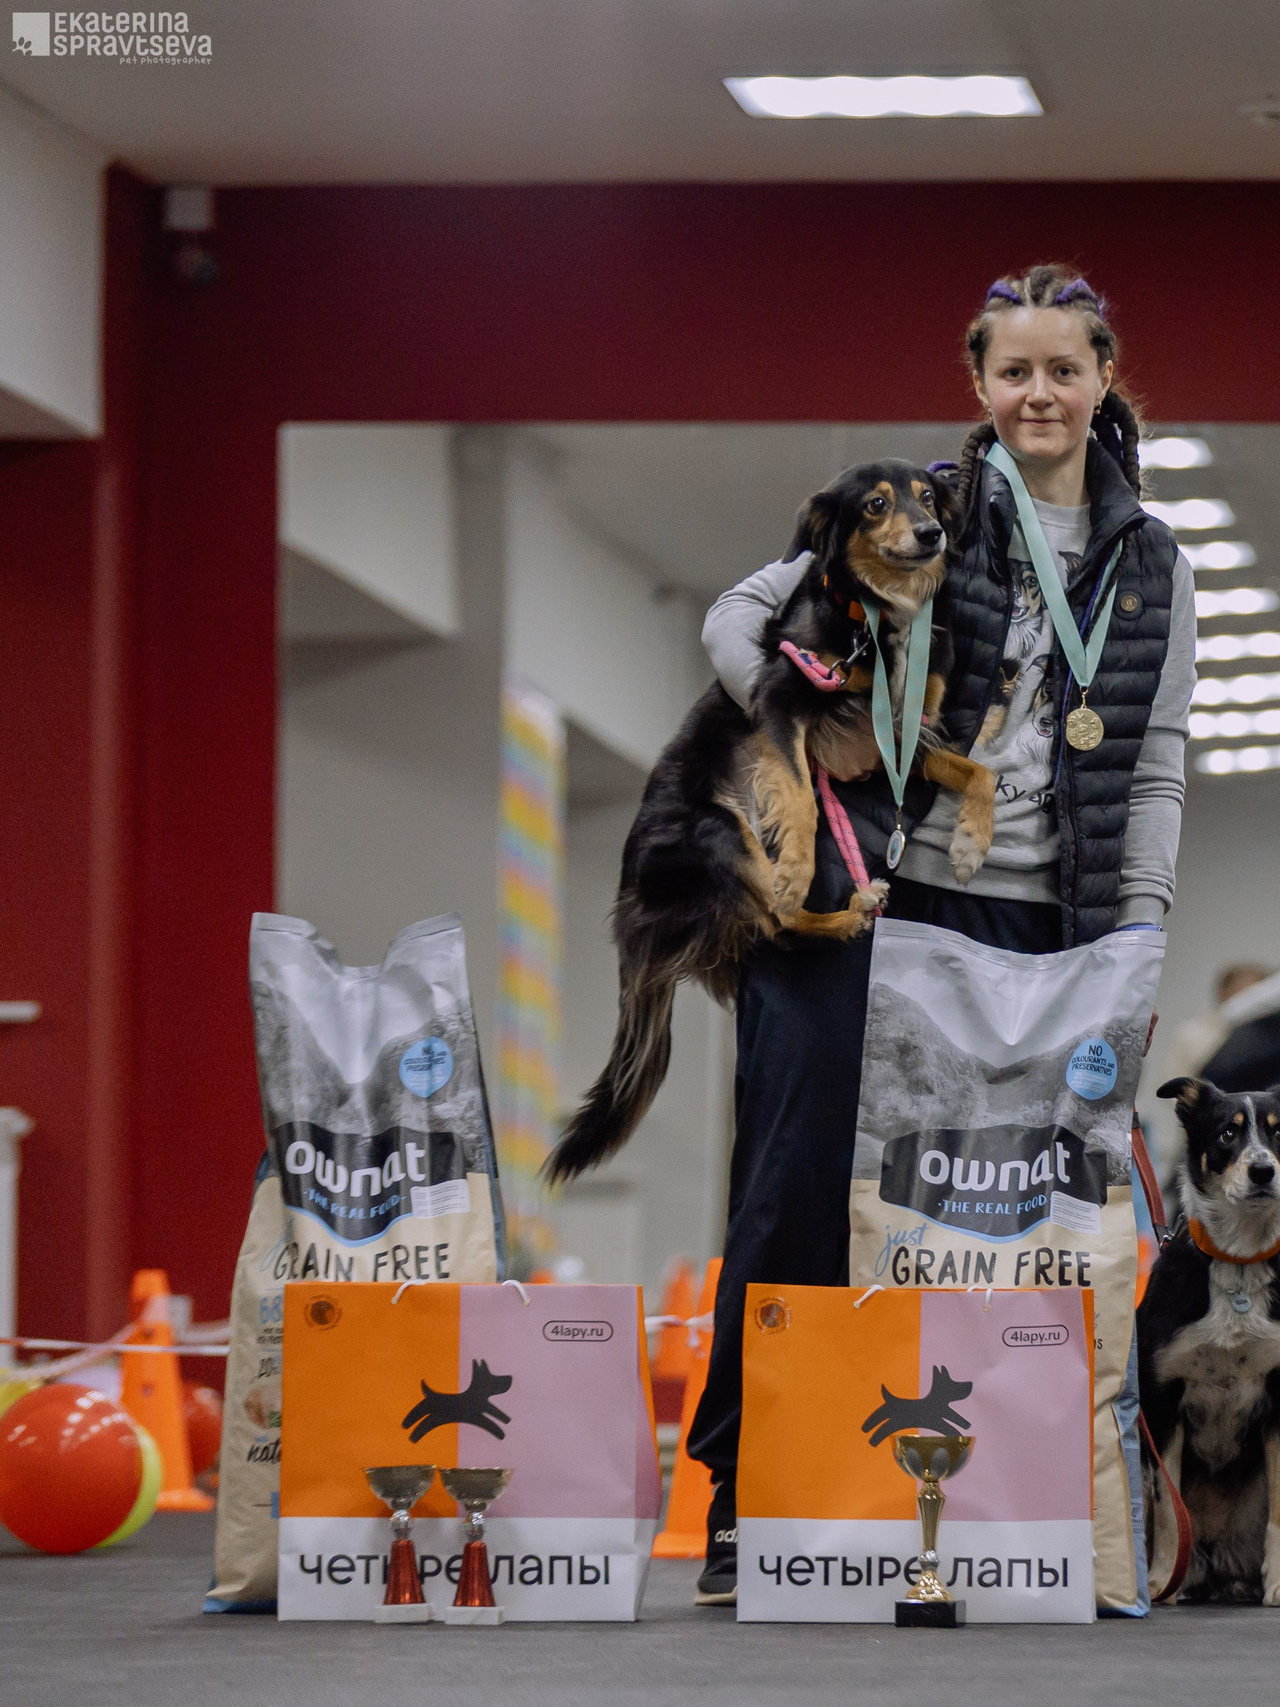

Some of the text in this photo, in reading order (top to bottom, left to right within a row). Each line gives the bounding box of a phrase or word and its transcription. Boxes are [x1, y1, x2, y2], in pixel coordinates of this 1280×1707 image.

[1088, 1044, 1103, 1056] NO
[285, 1140, 426, 1197] ownat
[919, 1141, 1071, 1192] ownat
[942, 1194, 1047, 1215] THE REAL FOOD
[373, 1243, 450, 1282] FREE
[874, 1222, 929, 1278] just
[892, 1246, 1092, 1288] GRAIN FREE
[550, 1325, 604, 1339] 4lapy.ru
[1010, 1330, 1061, 1344] 4lapy.ru
[946, 1556, 1069, 1588] лапы
